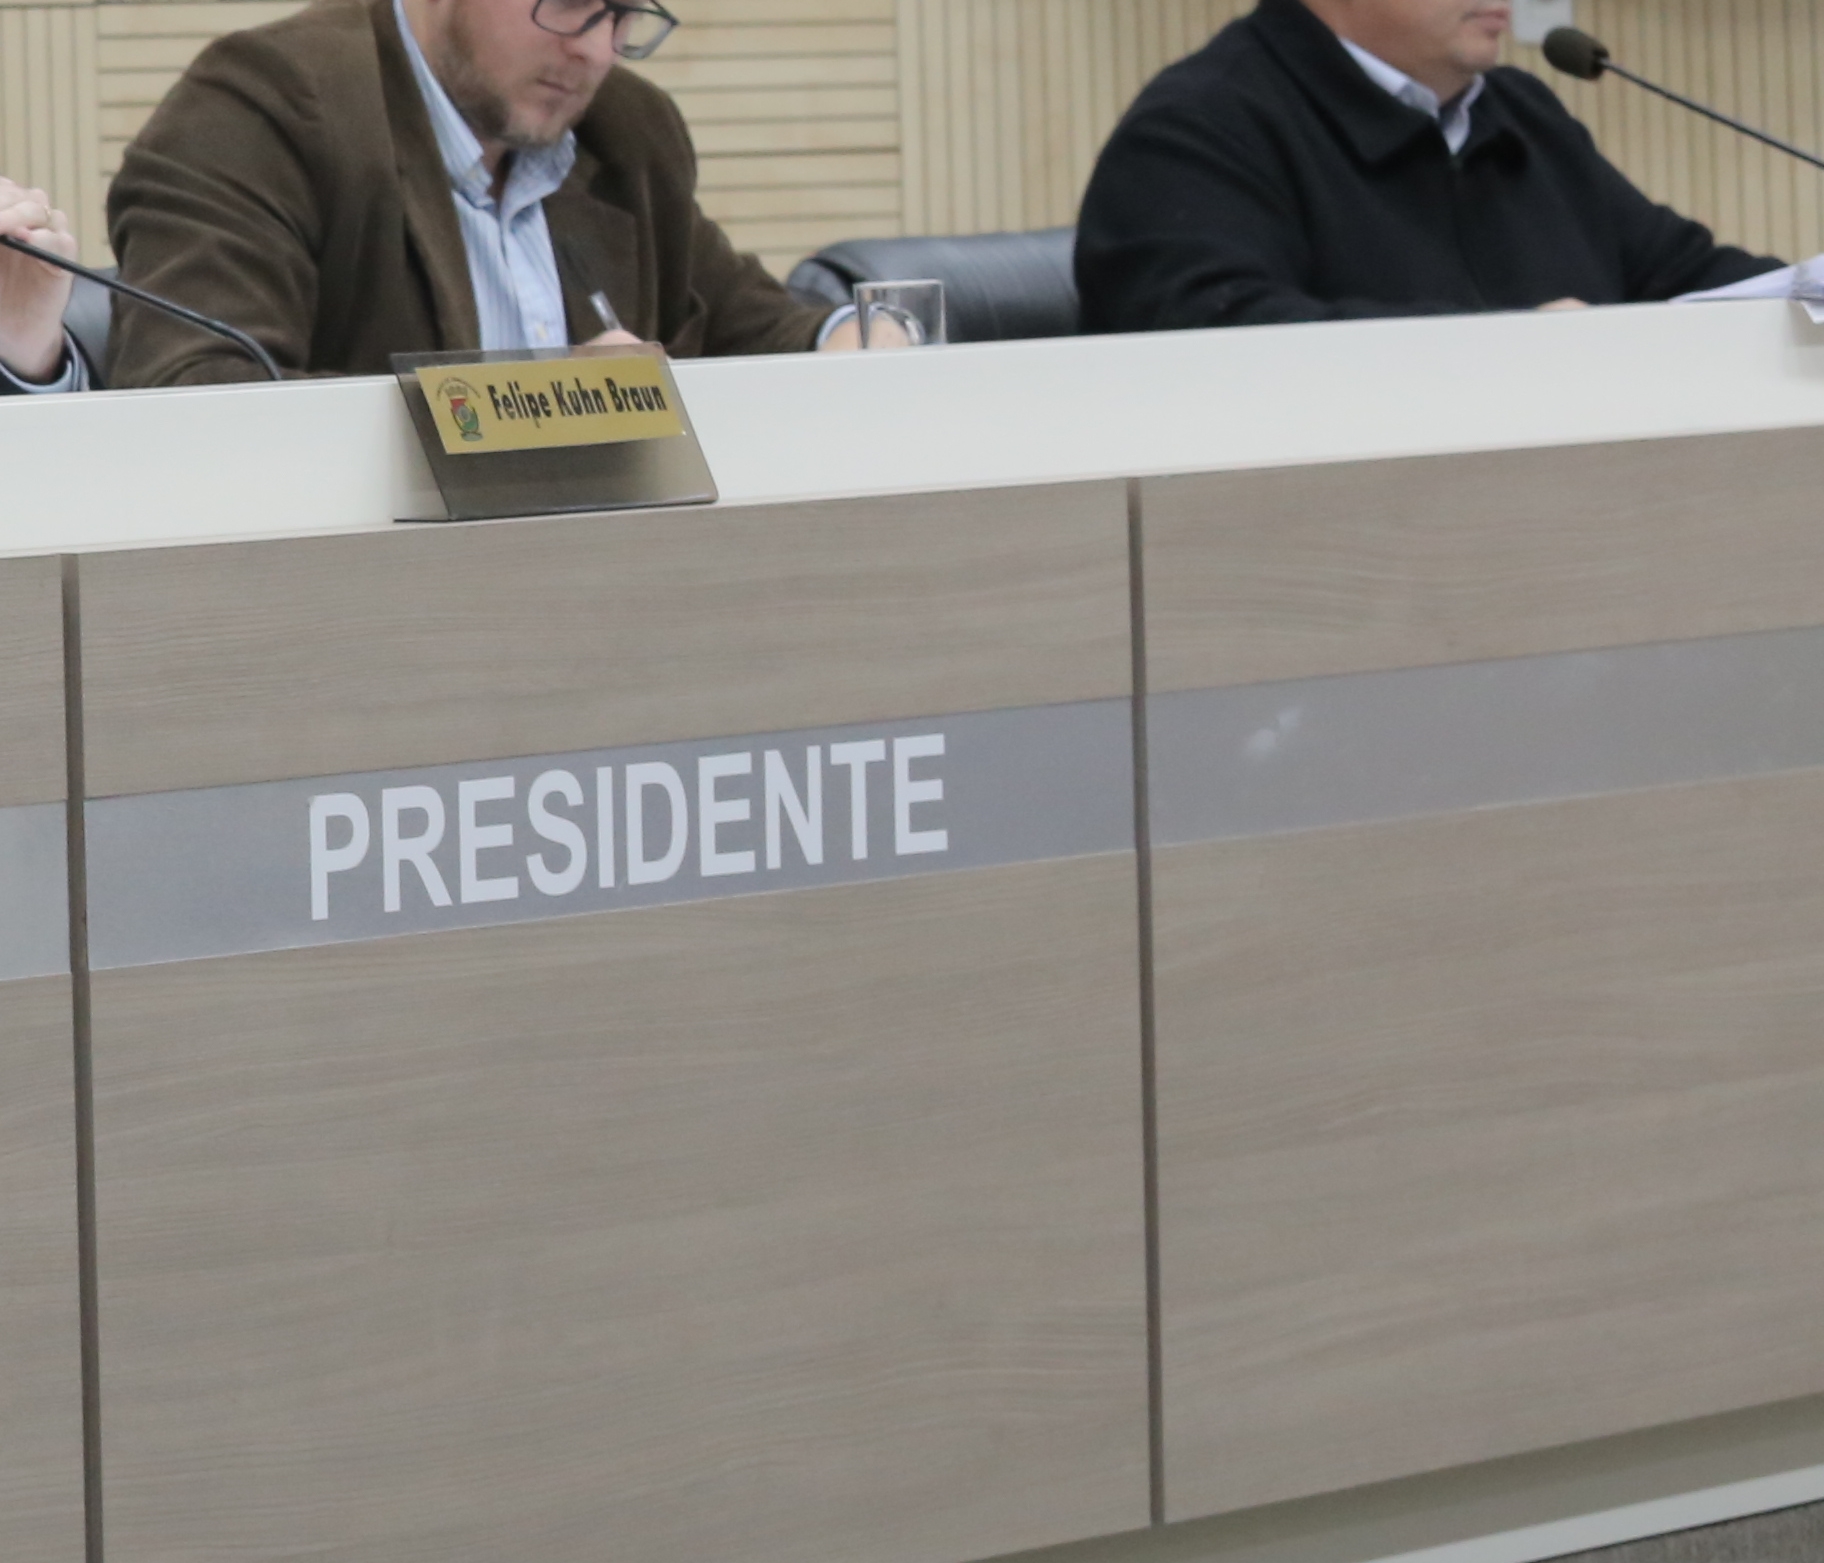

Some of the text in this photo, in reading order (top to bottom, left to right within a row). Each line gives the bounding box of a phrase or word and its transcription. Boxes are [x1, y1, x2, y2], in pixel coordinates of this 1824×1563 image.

[487, 380, 553, 429] Felipe
[551, 377, 609, 417] Kuhn
[605, 377, 669, 413] Braun
[306, 732, 950, 922] PRESIDENTE
